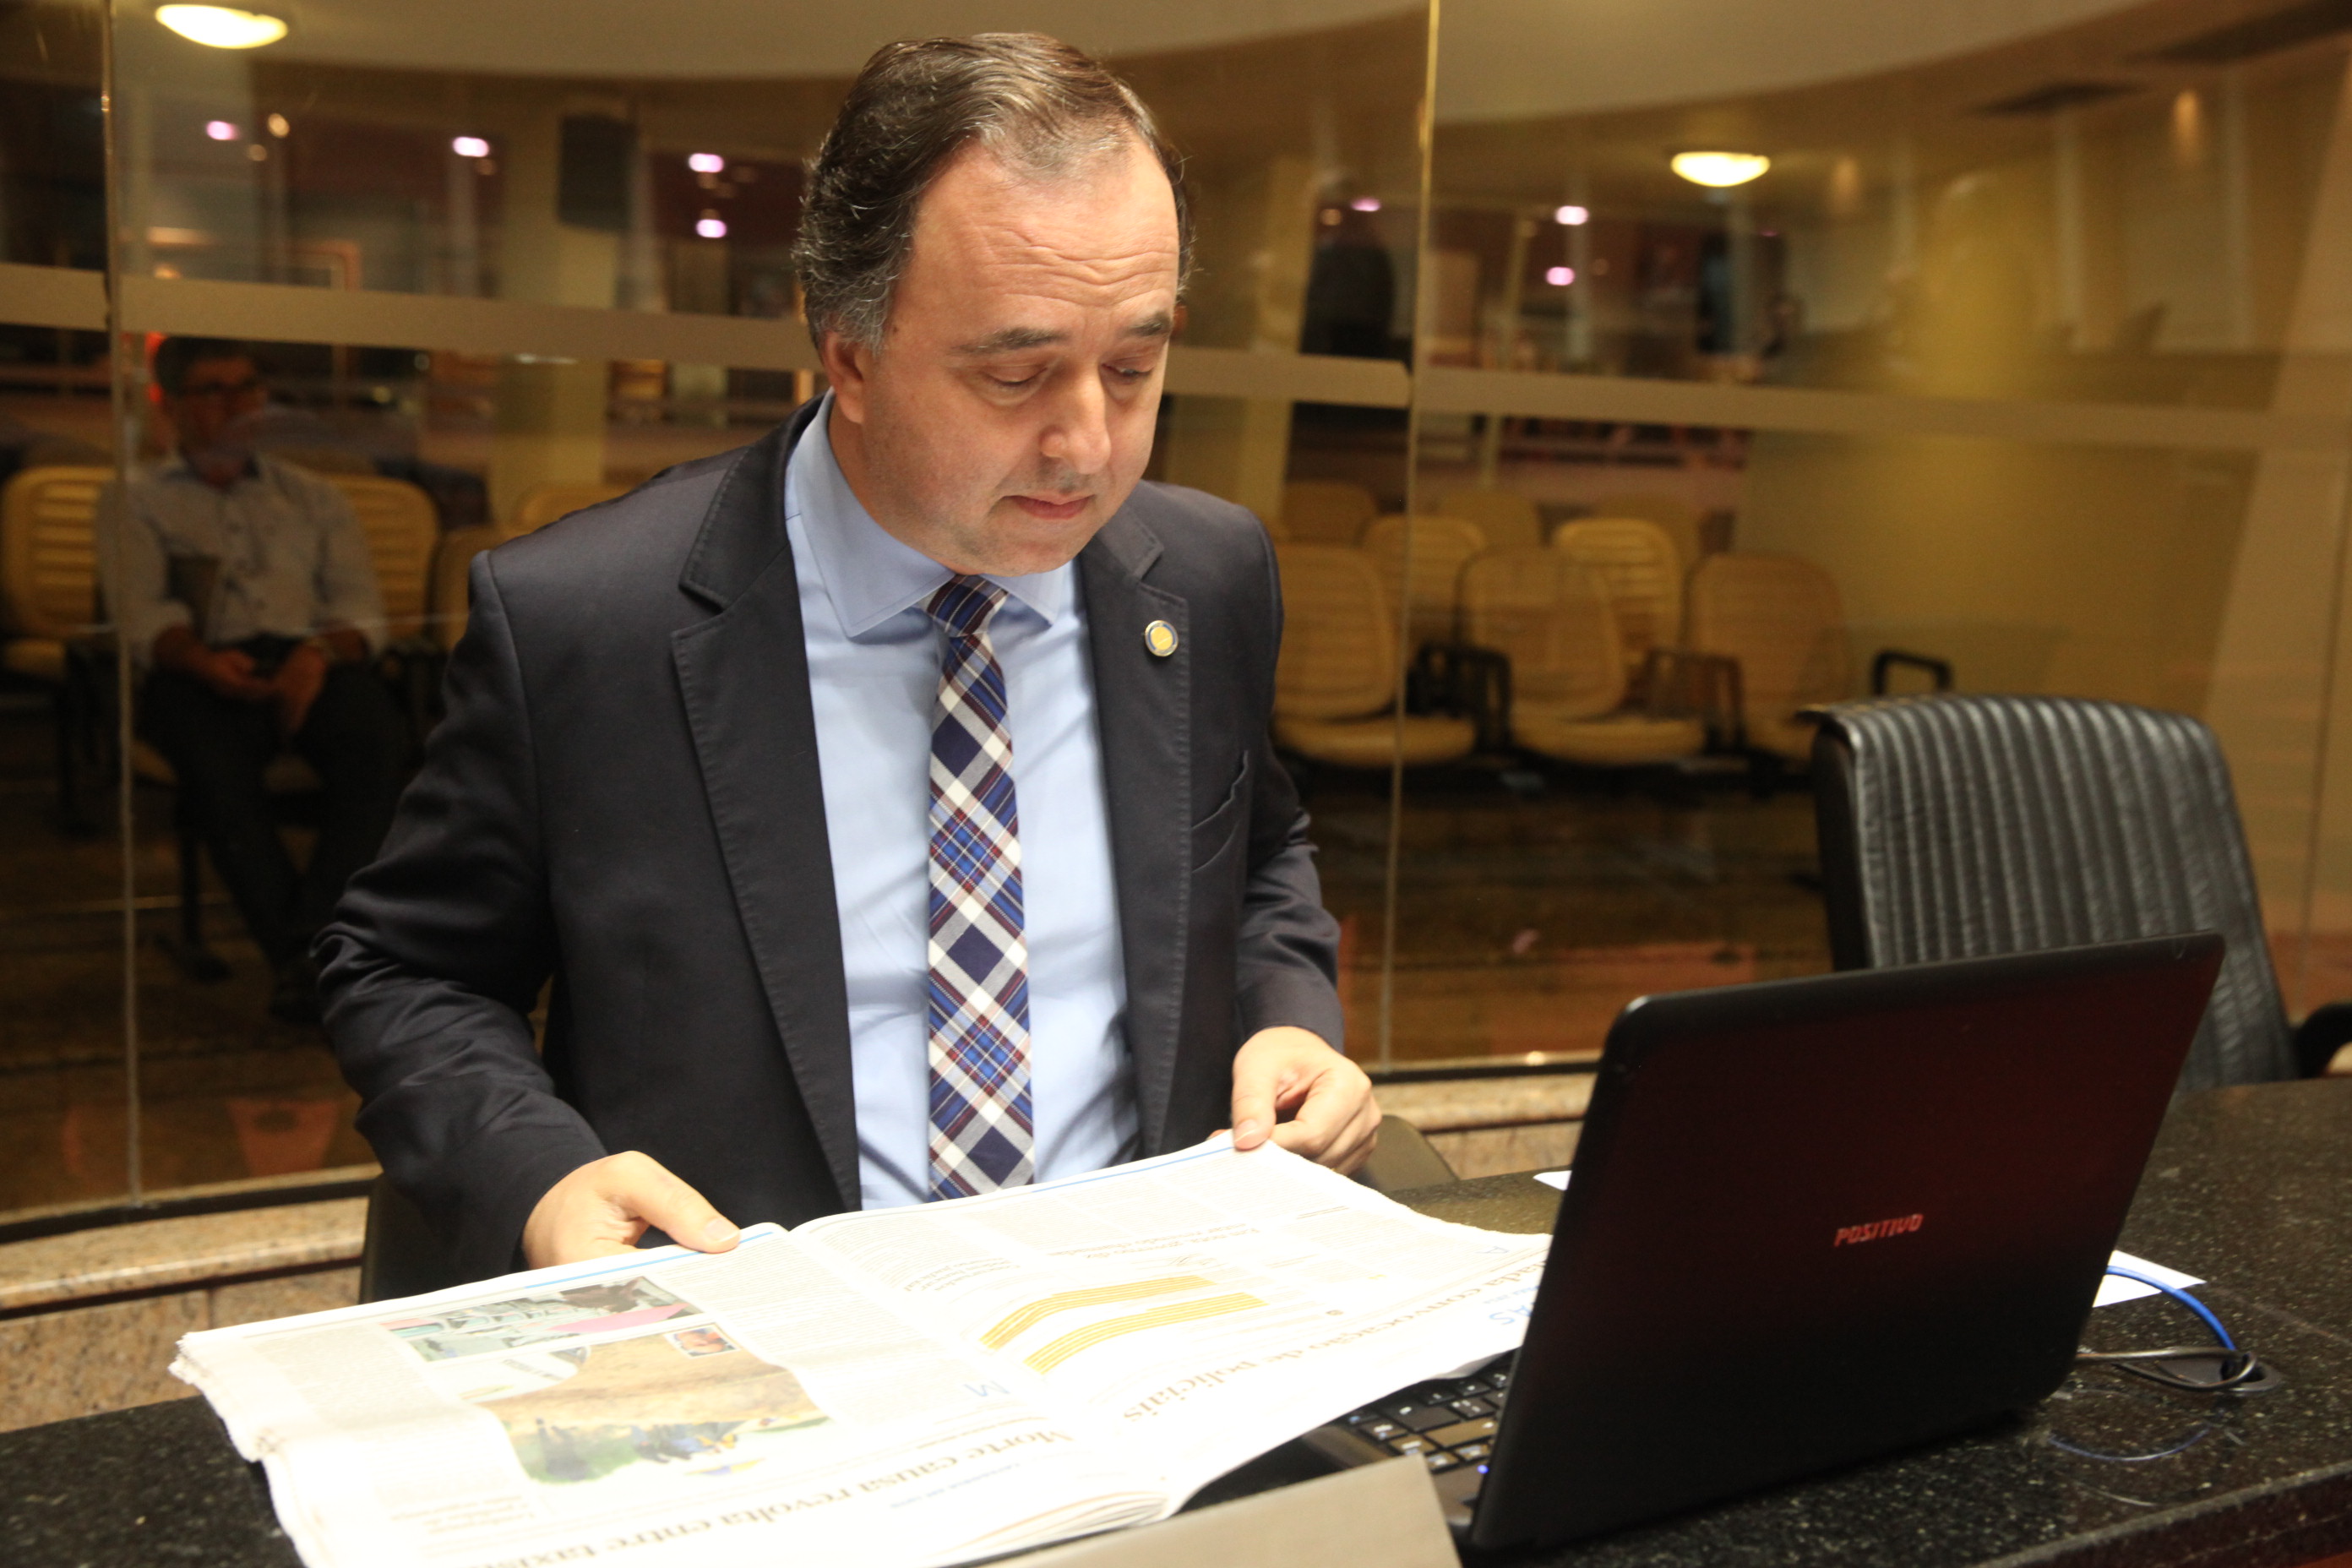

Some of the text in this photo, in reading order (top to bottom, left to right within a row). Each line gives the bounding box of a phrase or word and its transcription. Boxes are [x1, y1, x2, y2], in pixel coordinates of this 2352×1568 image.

[1833, 1213, 1925, 1248] POSITIVO
[1309, 1288, 1482, 1349] convocação
[1263, 1349, 1304, 1364] de
[963, 1380, 1011, 1397] M
[1123, 1360, 1260, 1422] policiais
[967, 1431, 1075, 1459] Morte
[858, 1456, 958, 1494] causa
[721, 1487, 852, 1527] revolta
[607, 1520, 711, 1552] entre
